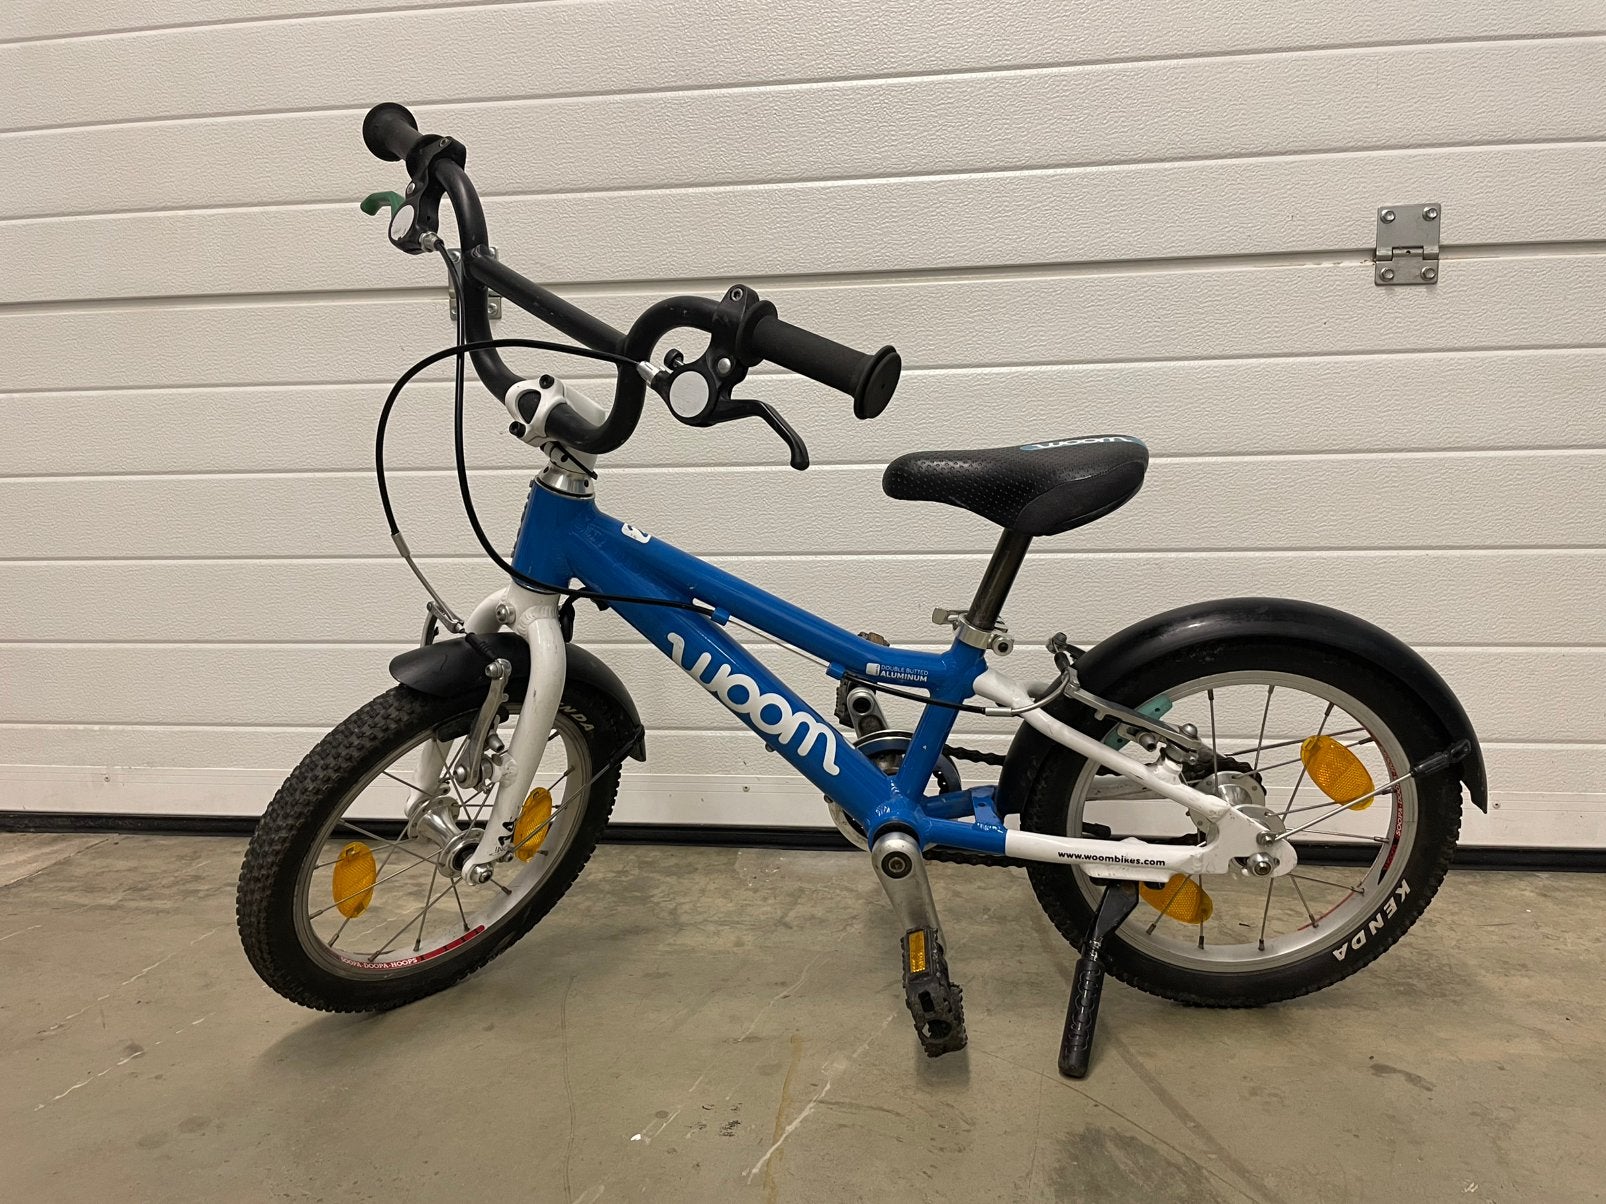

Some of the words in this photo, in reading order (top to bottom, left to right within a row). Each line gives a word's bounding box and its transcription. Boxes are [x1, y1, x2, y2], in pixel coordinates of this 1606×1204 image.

[880, 670, 928, 682] ALUMINUM
[881, 665, 905, 673] DOUBLE
[906, 667, 929, 676] BUTTED
[667, 632, 840, 776] woom
[559, 702, 595, 731] NDA
[1058, 851, 1166, 866] www.woombikes.com
[1332, 878, 1411, 961] KENDA
